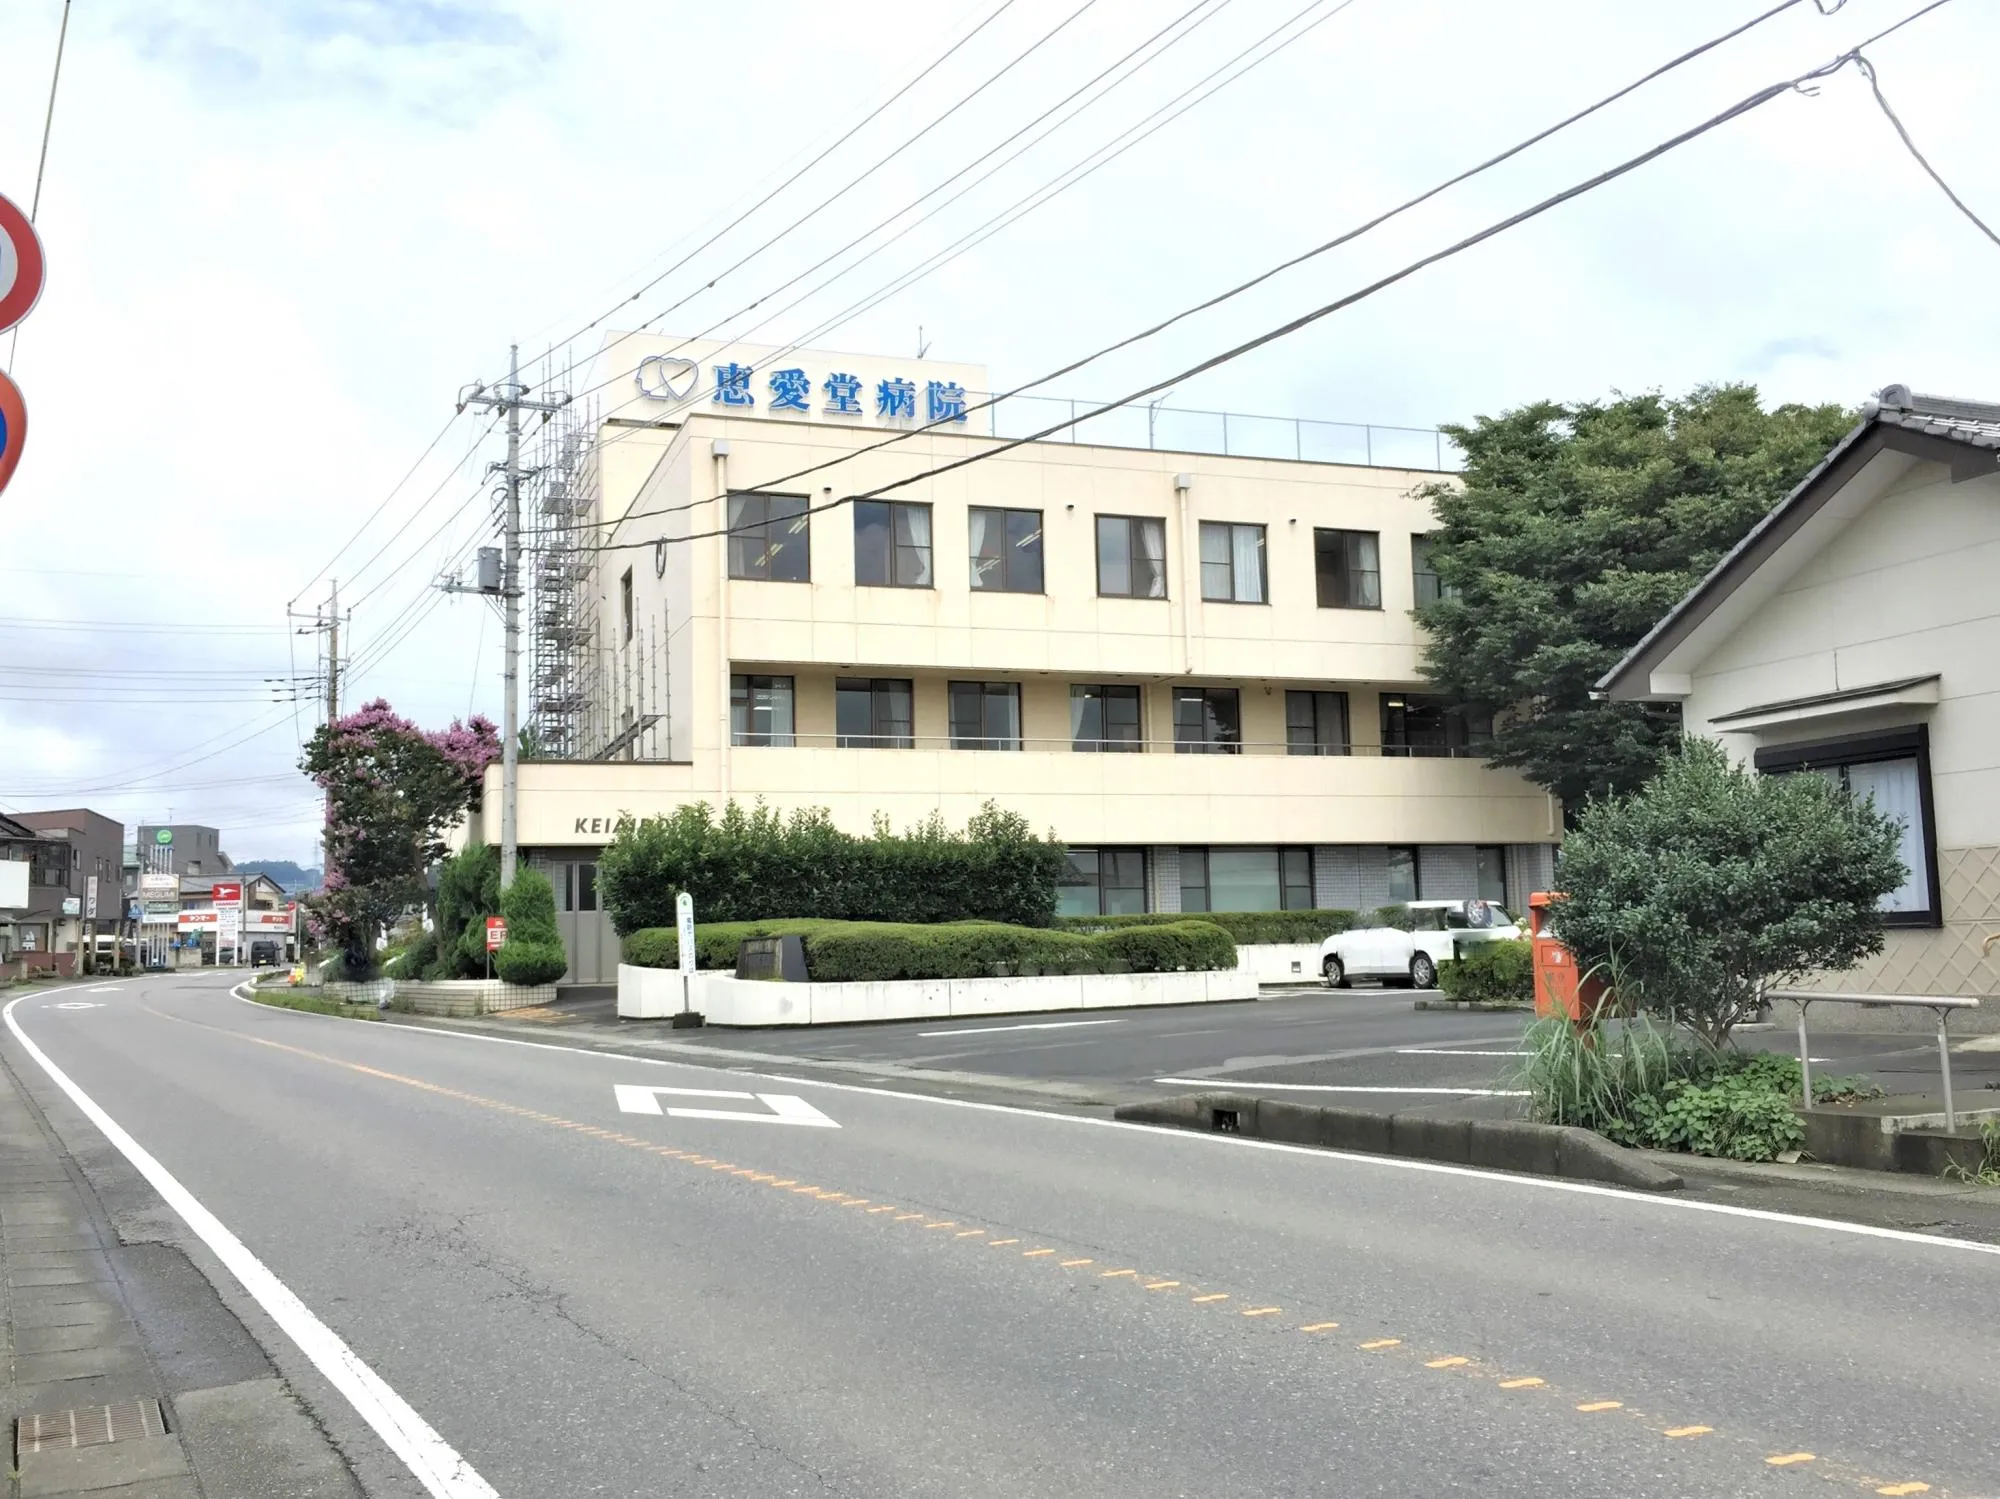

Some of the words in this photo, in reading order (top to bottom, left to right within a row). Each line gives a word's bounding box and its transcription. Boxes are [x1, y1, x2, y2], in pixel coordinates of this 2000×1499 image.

[713, 362, 968, 423] 恵愛堂病院
